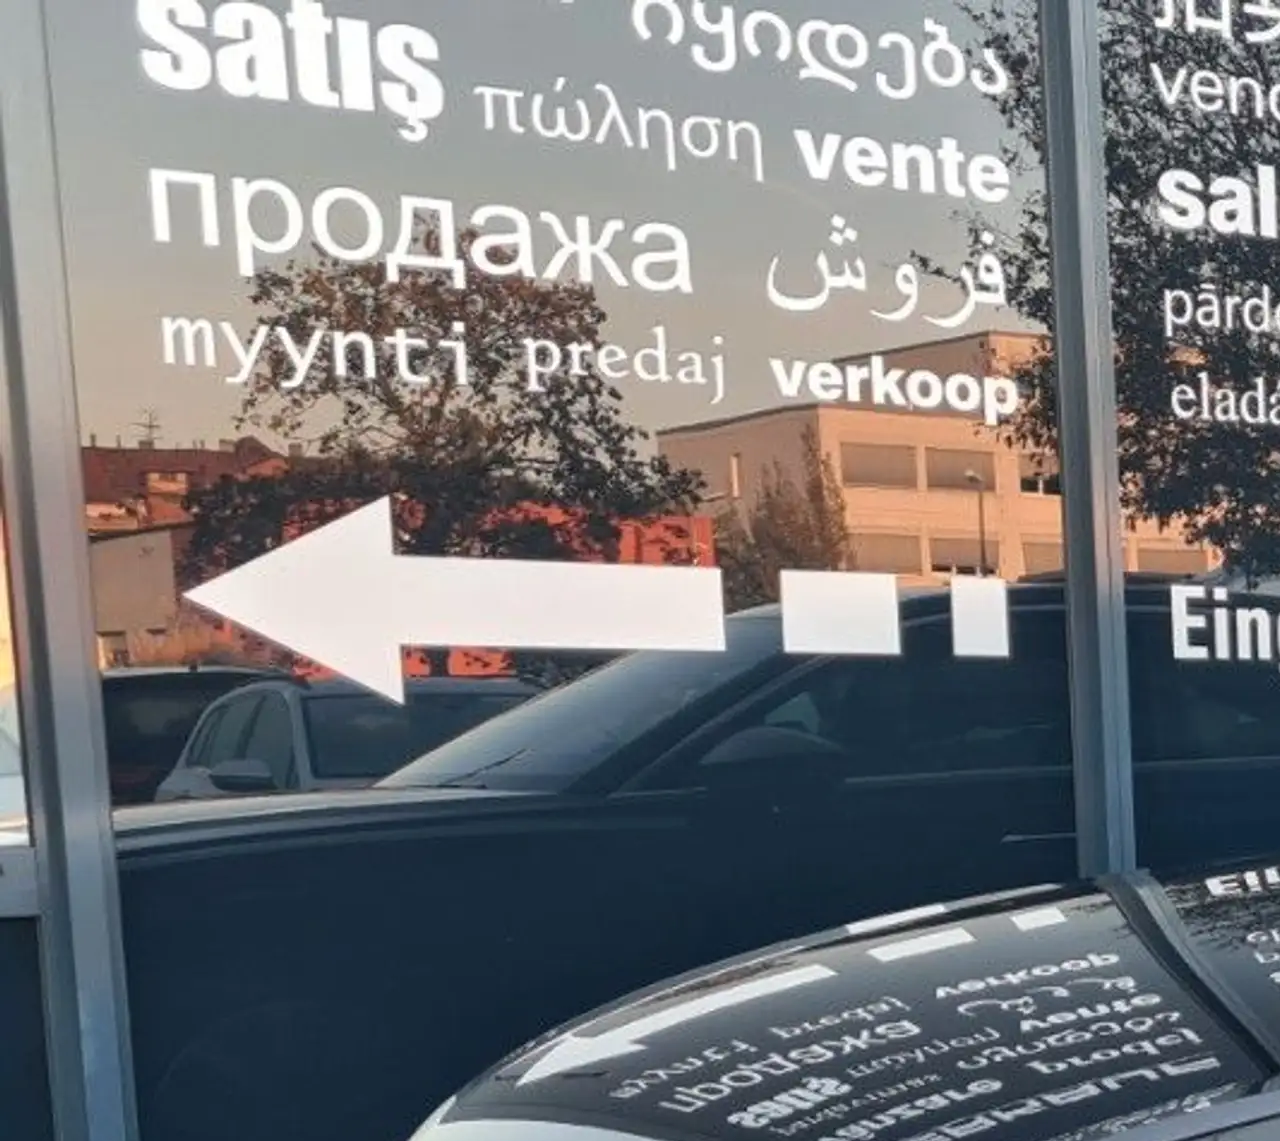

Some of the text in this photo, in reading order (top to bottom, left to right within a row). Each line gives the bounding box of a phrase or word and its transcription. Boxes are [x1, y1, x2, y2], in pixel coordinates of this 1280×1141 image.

[136, 0, 444, 141] satış
[473, 77, 764, 183] πώληση
[793, 128, 1011, 202] vente
[148, 167, 693, 294] продажа
[160, 315, 1020, 426] myynti predaj verkoop
